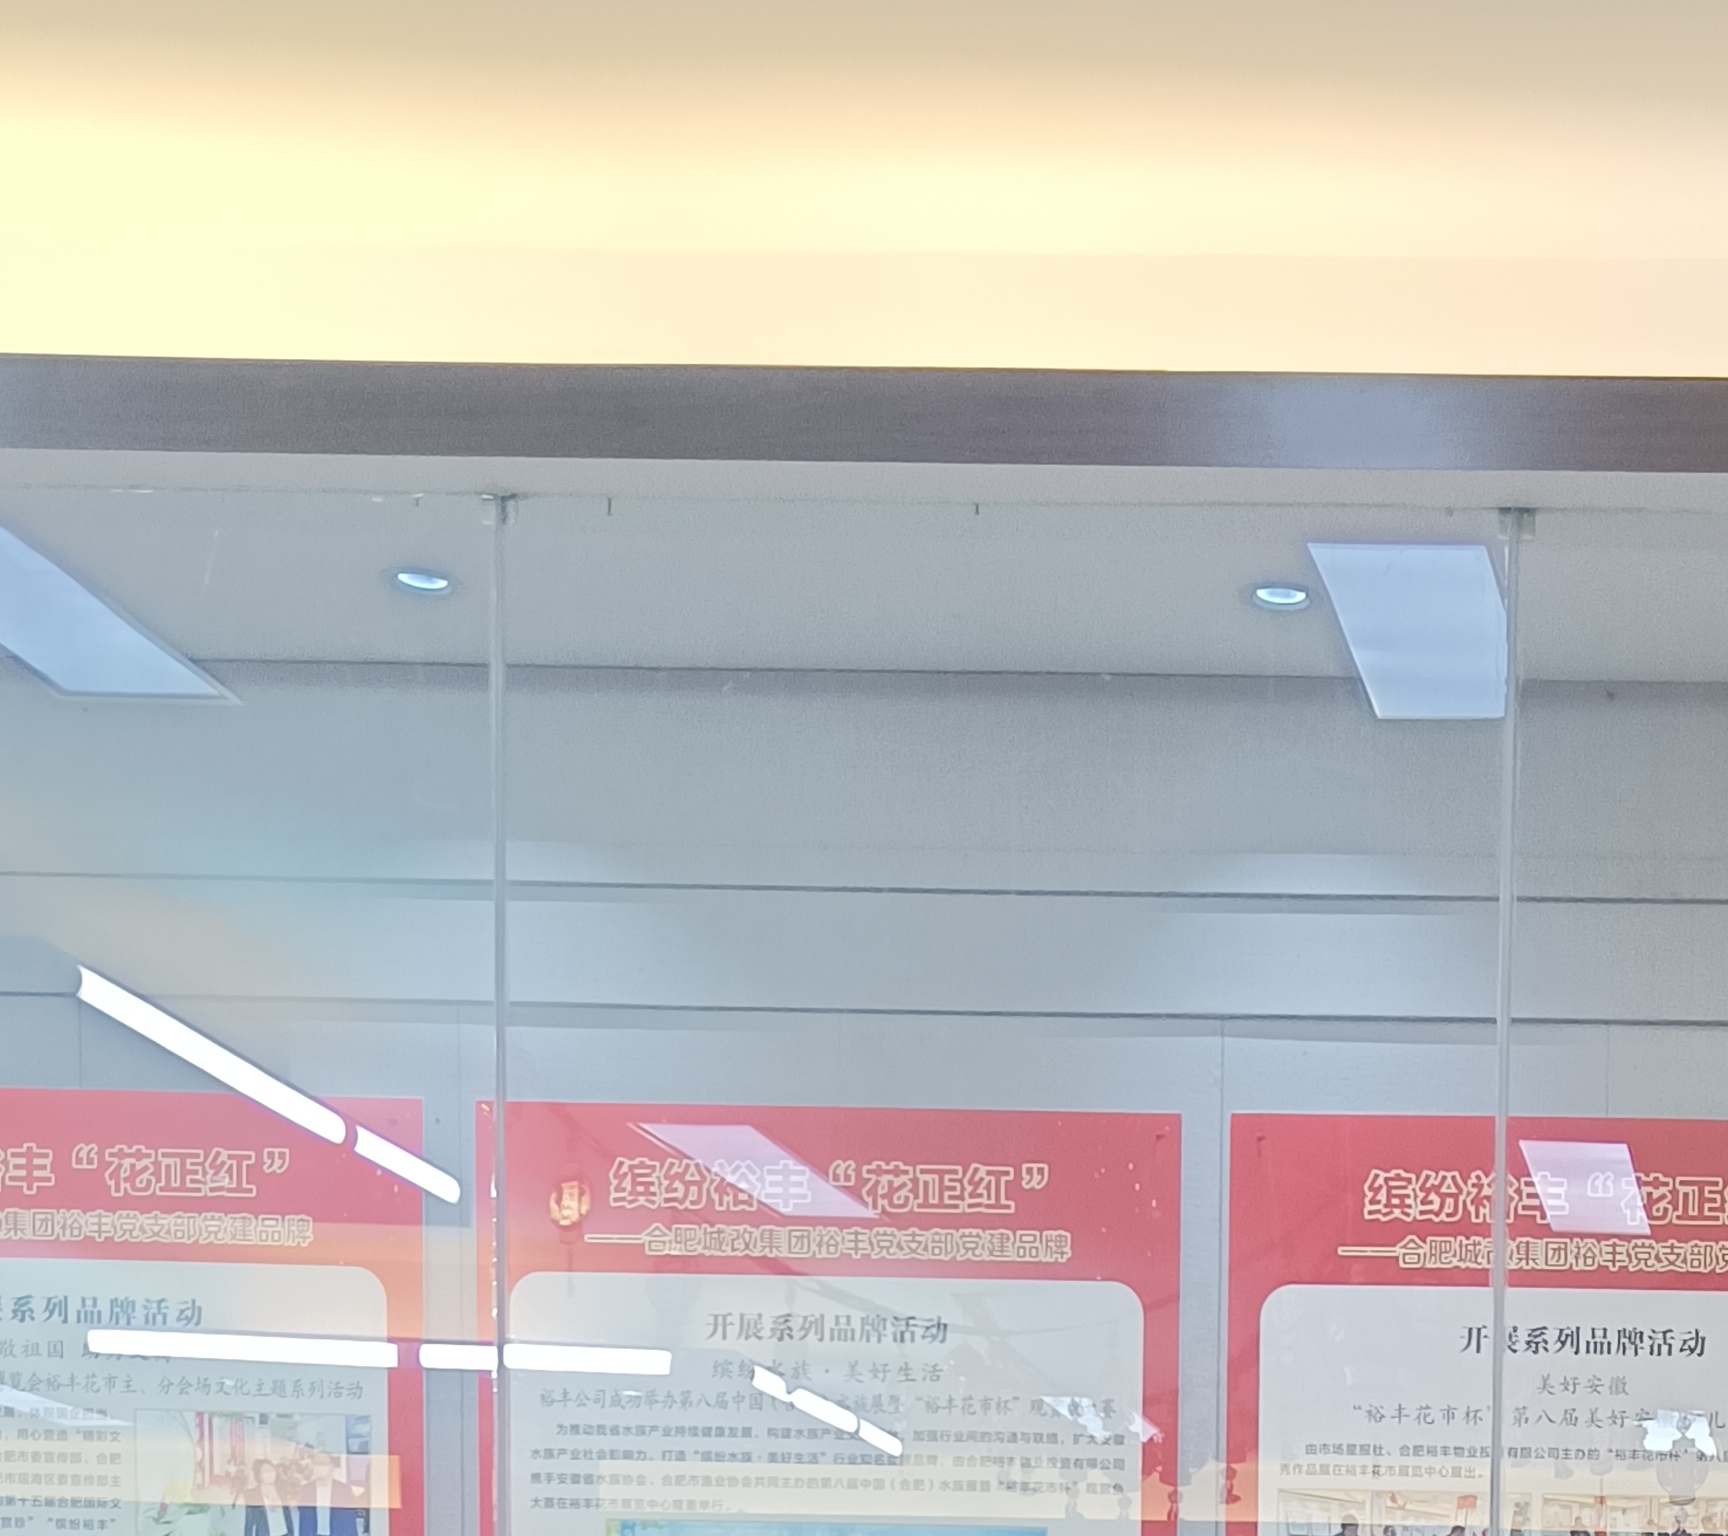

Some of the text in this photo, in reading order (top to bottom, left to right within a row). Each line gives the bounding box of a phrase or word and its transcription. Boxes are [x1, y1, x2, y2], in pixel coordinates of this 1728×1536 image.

[0, 1143, 291, 1197] 丰“花正红”
[0, 1207, 314, 1247] 集团裕丰党支部党建品牌
[0, 1294, 203, 1328] 系列品牌活动
[705, 1311, 949, 1345] 开展系列品牌活动
[1459, 1324, 1708, 1358] 开展系列品牌活动
[1536, 1373, 1631, 1397] 美好安徽
[0, 1450, 122, 1466] 肥市委宣传部、合肥
